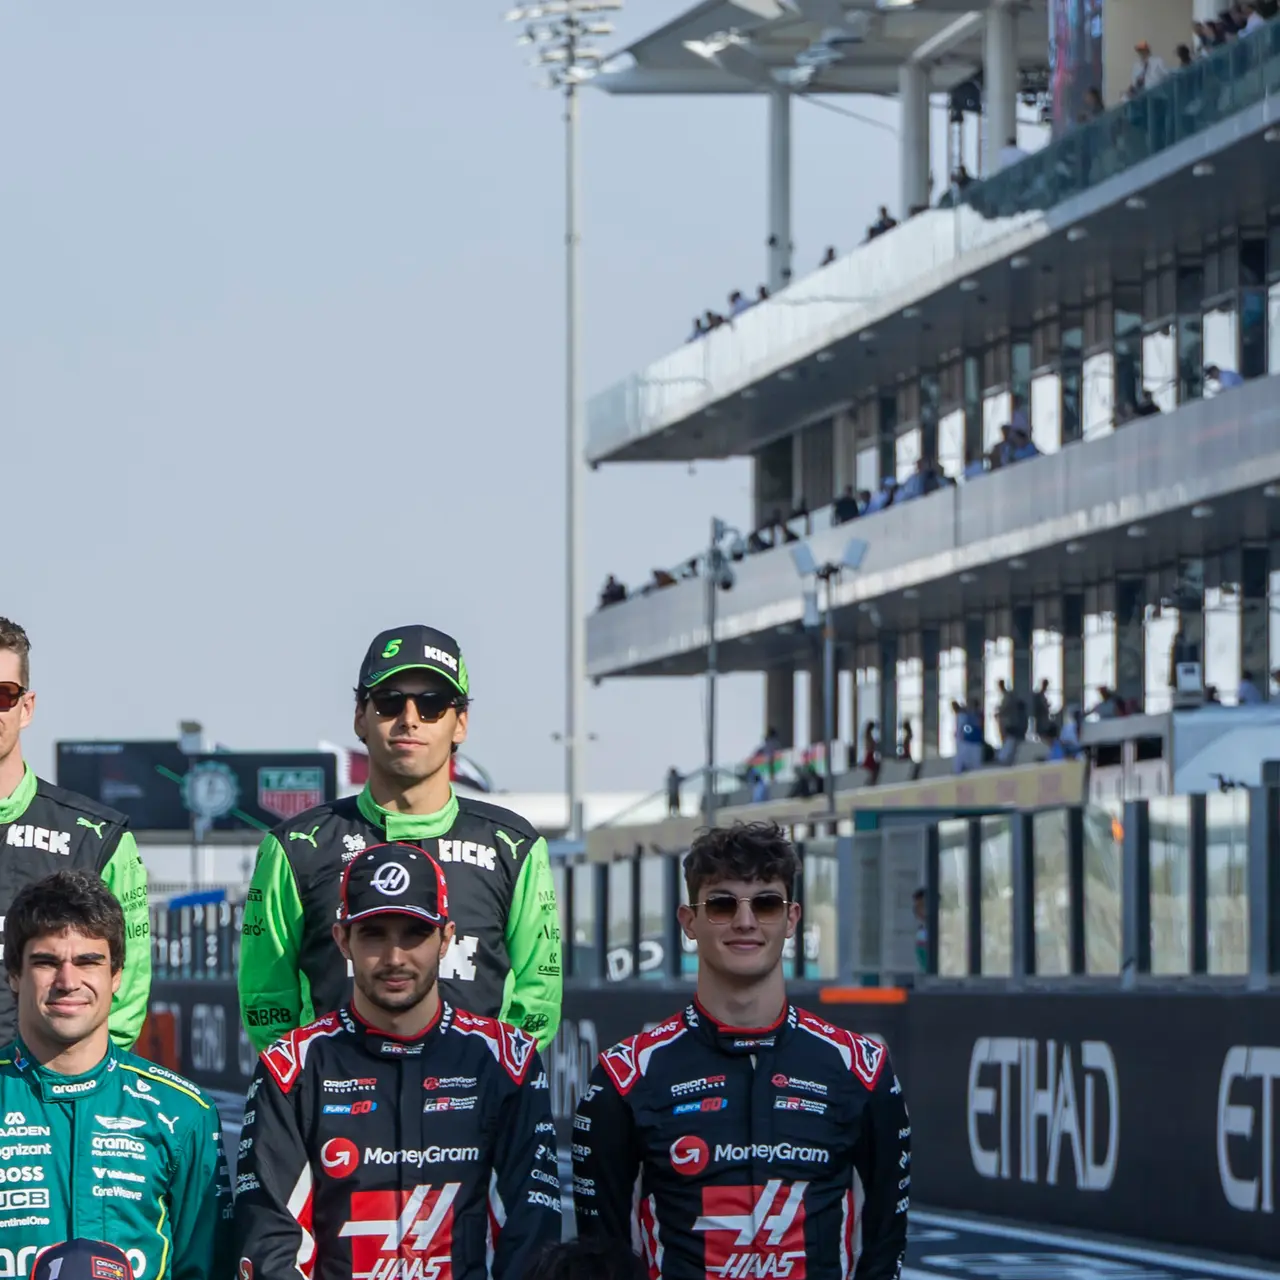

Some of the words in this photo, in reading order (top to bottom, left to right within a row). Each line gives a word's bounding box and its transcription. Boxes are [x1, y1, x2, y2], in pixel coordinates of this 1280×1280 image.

[382, 639, 402, 658] 5
[424, 645, 457, 671] KICK
[6, 824, 70, 855] KICK
[439, 839, 496, 871] KICK
[260, 1007, 291, 1027] BRB
[52, 1080, 96, 1093] aramco
[149, 1066, 201, 1095] coinbase
[967, 1036, 1119, 1191] ETIHAD
[92, 1138, 144, 1152] aramco
[715, 1143, 829, 1163] MoneyGram
[363, 1146, 479, 1168] MoneyGram
[92, 1186, 142, 1200] CoreWeave
[48, 1257, 63, 1280] 1
[705, 1251, 806, 1279] HAAS
